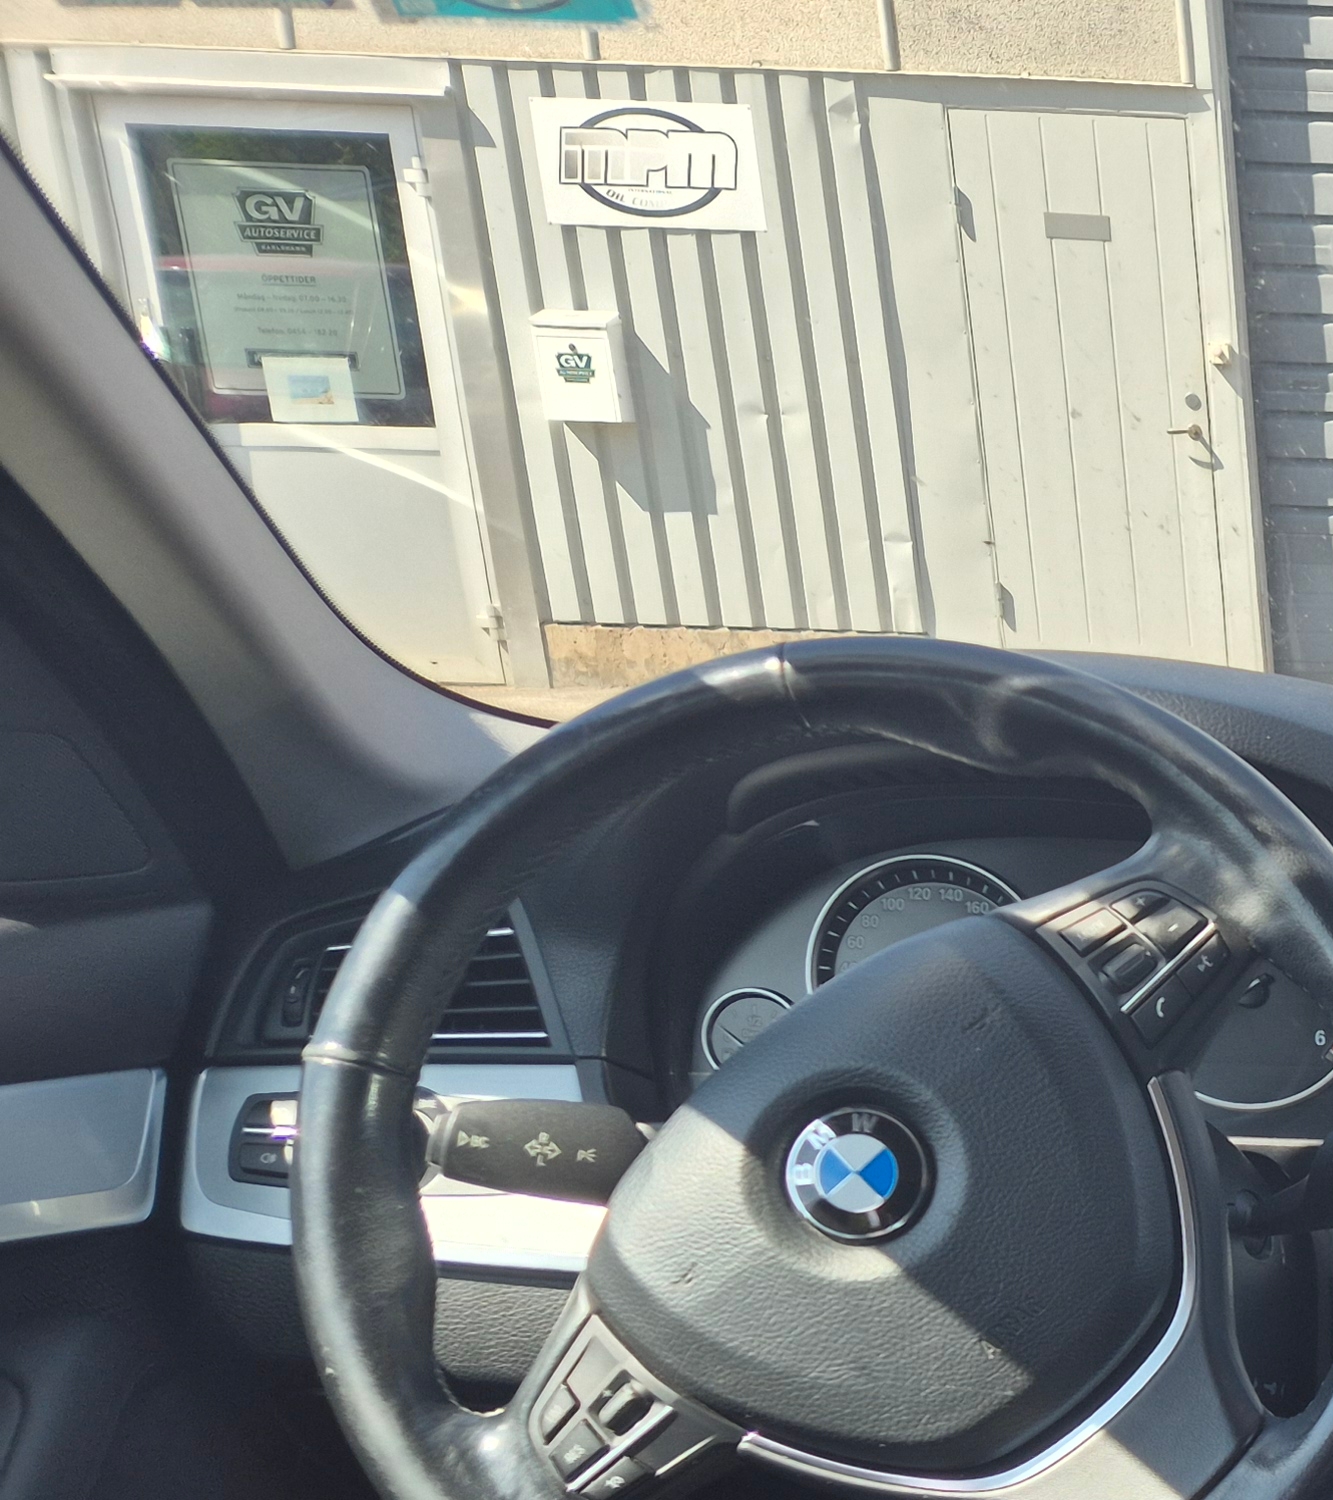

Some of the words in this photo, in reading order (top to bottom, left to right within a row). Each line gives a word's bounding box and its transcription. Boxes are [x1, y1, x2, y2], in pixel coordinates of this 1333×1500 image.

[606, 189, 625, 202] OIL
[245, 193, 305, 221] GV
[243, 227, 317, 240] AUTOSERVICE
[261, 273, 317, 284] ÖPPETTIDER
[559, 354, 589, 368] GV
[907, 887, 931, 900] 120
[939, 888, 963, 902] 140
[881, 898, 905, 911] 100
[965, 901, 990, 914] 160
[861, 915, 879, 928] 80
[847, 935, 865, 949] 60
[1314, 1029, 1327, 1046] 6
[794, 1113, 878, 1186] BMW
